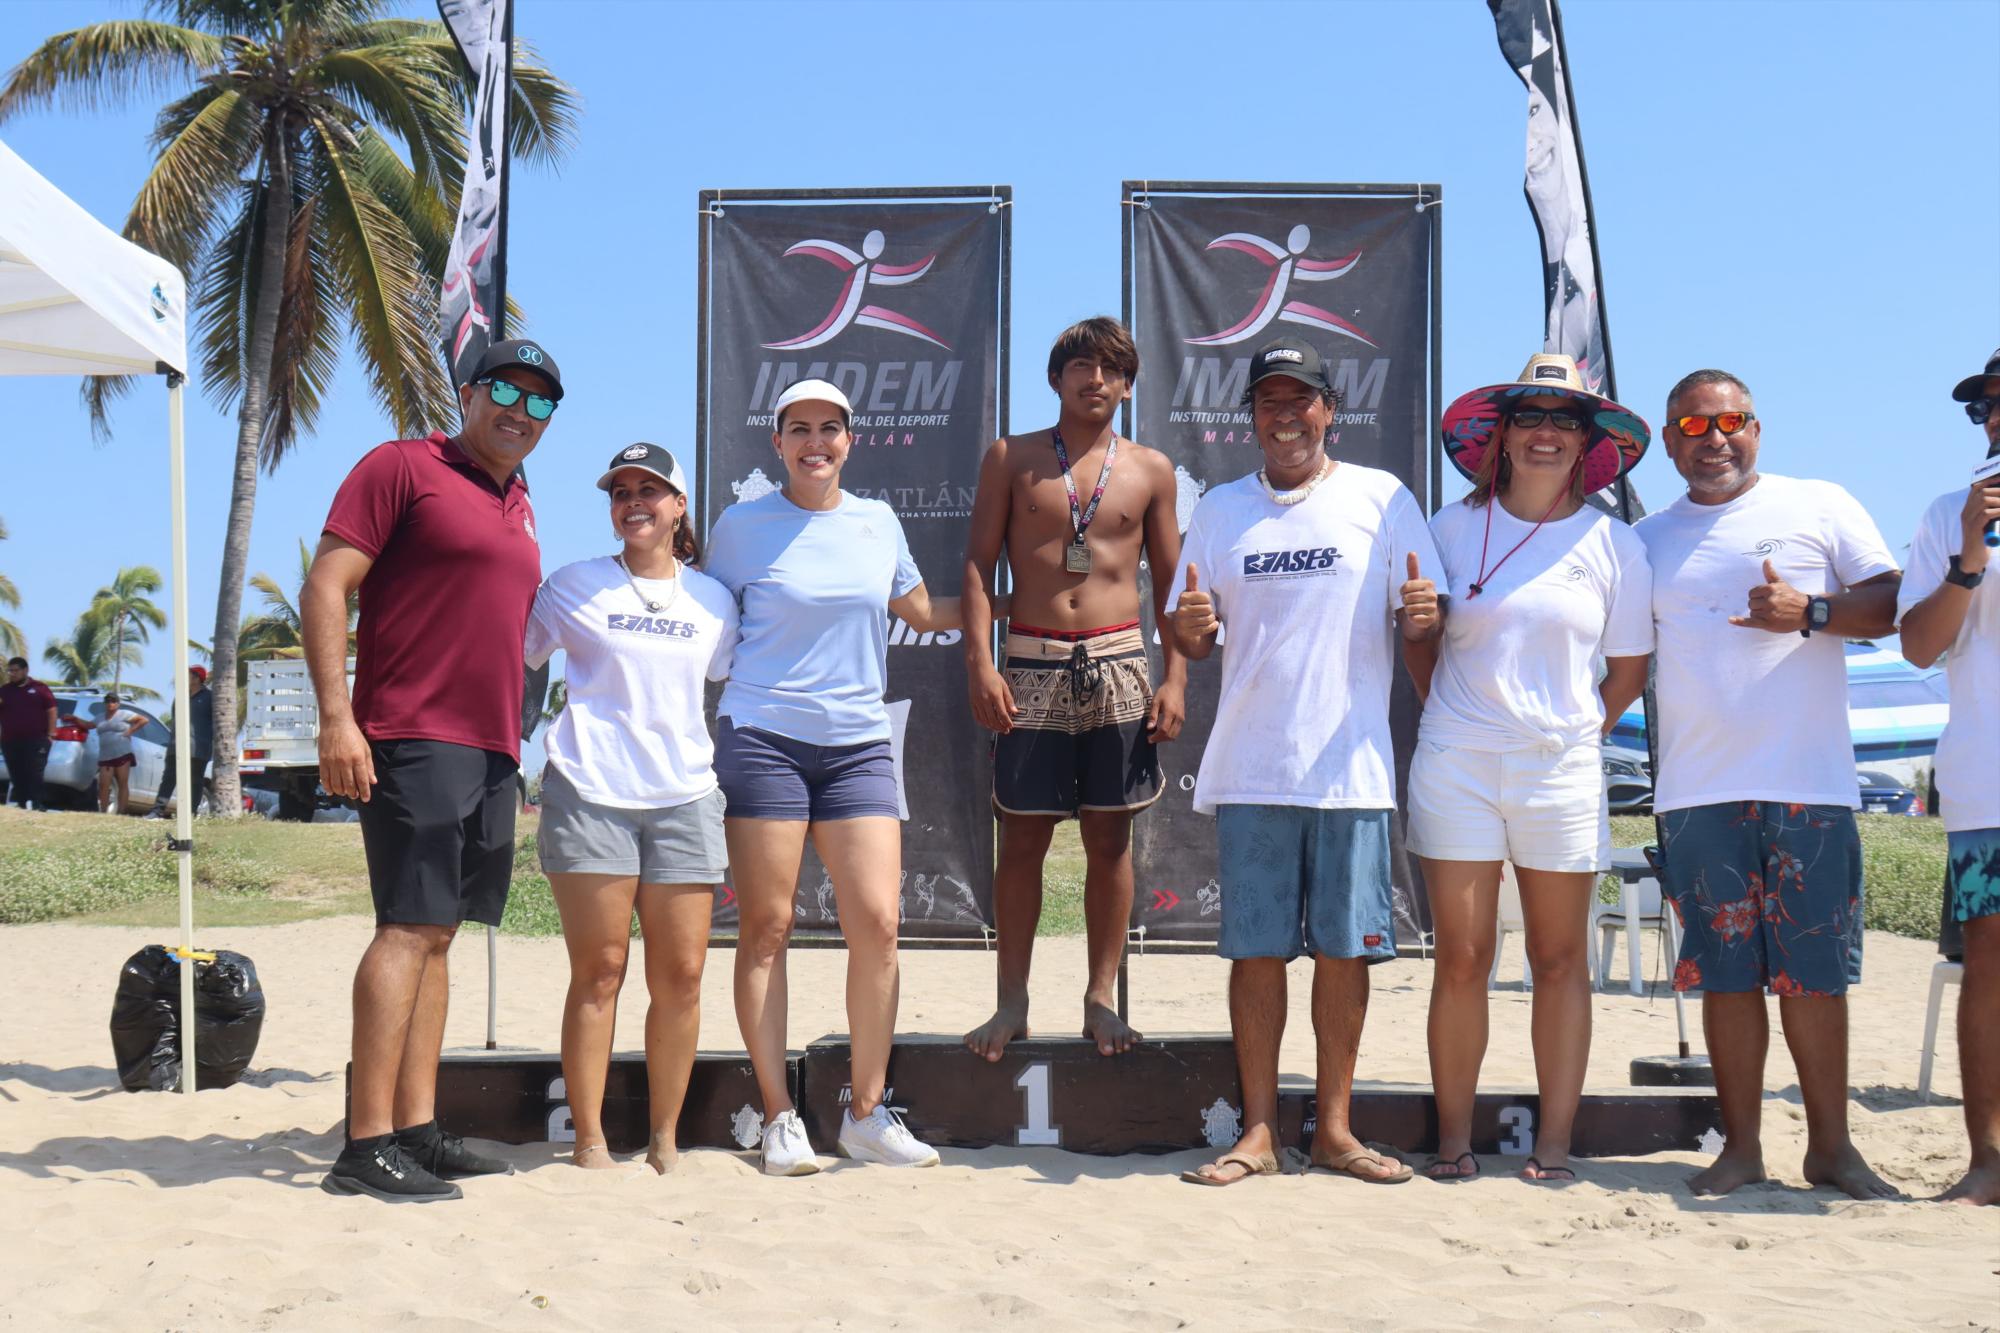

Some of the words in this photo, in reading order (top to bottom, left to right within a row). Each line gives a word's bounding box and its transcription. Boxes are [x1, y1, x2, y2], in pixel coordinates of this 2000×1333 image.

[1171, 357, 1391, 409] IMM
[875, 415, 896, 427] DEL
[898, 414, 950, 427] DEPORTE
[1169, 411, 1230, 424] INSTITUTO
[1333, 413, 1377, 425] EPORTE
[854, 431, 914, 446] TLÁN
[855, 481, 978, 509] ZATLÁN
[1271, 547, 1340, 573] ASES
[635, 617, 697, 638] ASES
[838, 1087, 894, 1102] IMM
[1018, 1065, 1059, 1145] 1
[1499, 1106, 1533, 1155] 3
